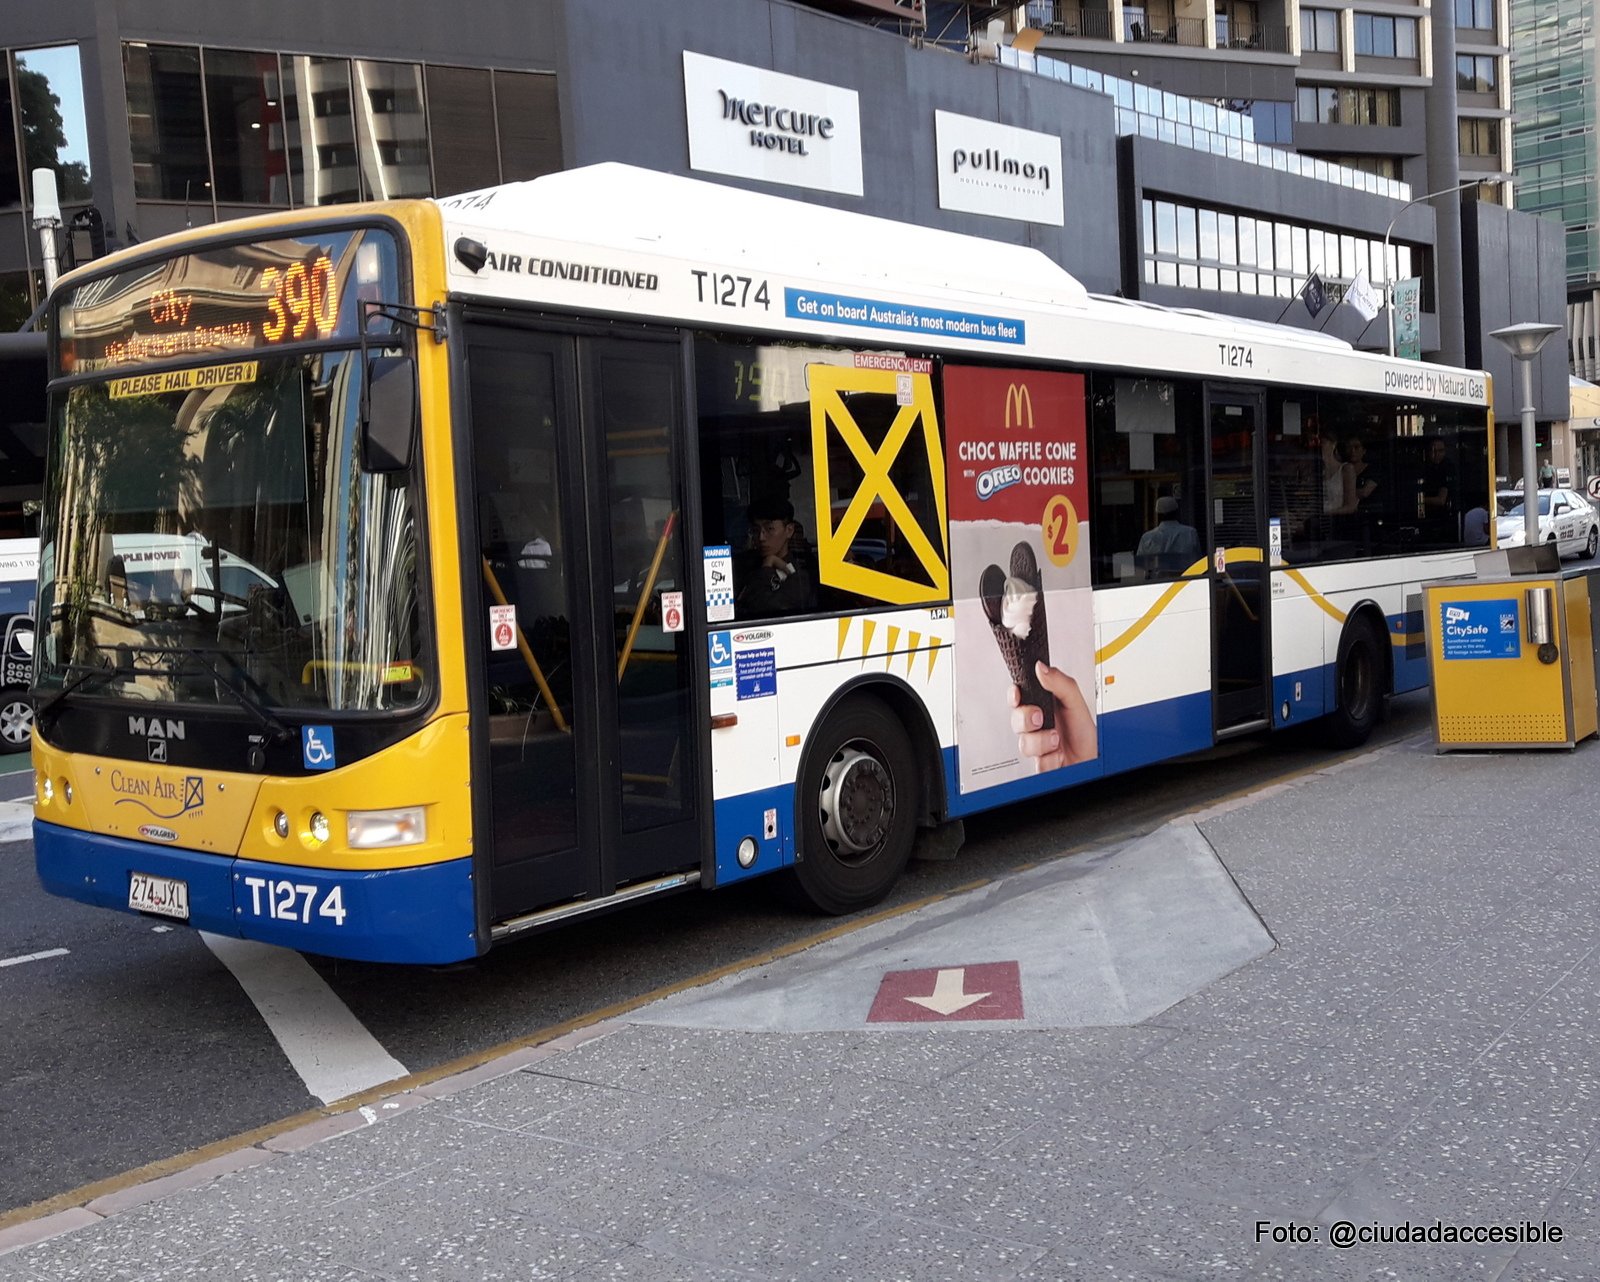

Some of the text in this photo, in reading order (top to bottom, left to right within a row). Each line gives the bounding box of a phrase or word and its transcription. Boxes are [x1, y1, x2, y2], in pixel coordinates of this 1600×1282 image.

[749, 130, 809, 156] HOTEL
[953, 147, 1050, 190] pullman
[486, 251, 659, 291] AIR CONDITIONED
[150, 256, 338, 342] City 390
[690, 269, 771, 311] T1274
[796, 296, 1017, 339] Get on board Australia's most modern bus fleet
[854, 355, 932, 373] EMERGENCY EXIT
[1218, 343, 1253, 368] T1274
[120, 365, 242, 394] PLEASE HAIL DRIVER
[1384, 369, 1484, 399] powered by Natural Gas
[958, 440, 1077, 461] CHOC WAFFLE CONE
[978, 466, 1021, 496] OREO
[1023, 466, 1075, 486] COOKIES
[1047, 503, 1069, 556] $2
[144, 550, 181, 562] MOVER
[705, 548, 730, 557] WARNING
[711, 560, 724, 568] CCTV
[931, 608, 948, 619] APN
[745, 632, 771, 640] VOLGREN
[1446, 625, 1489, 637] CitySafe
[747, 652, 755, 660] help
[128, 715, 186, 740] MAN
[148, 827, 176, 840] VOLGREN
[245, 876, 346, 926] T1274
